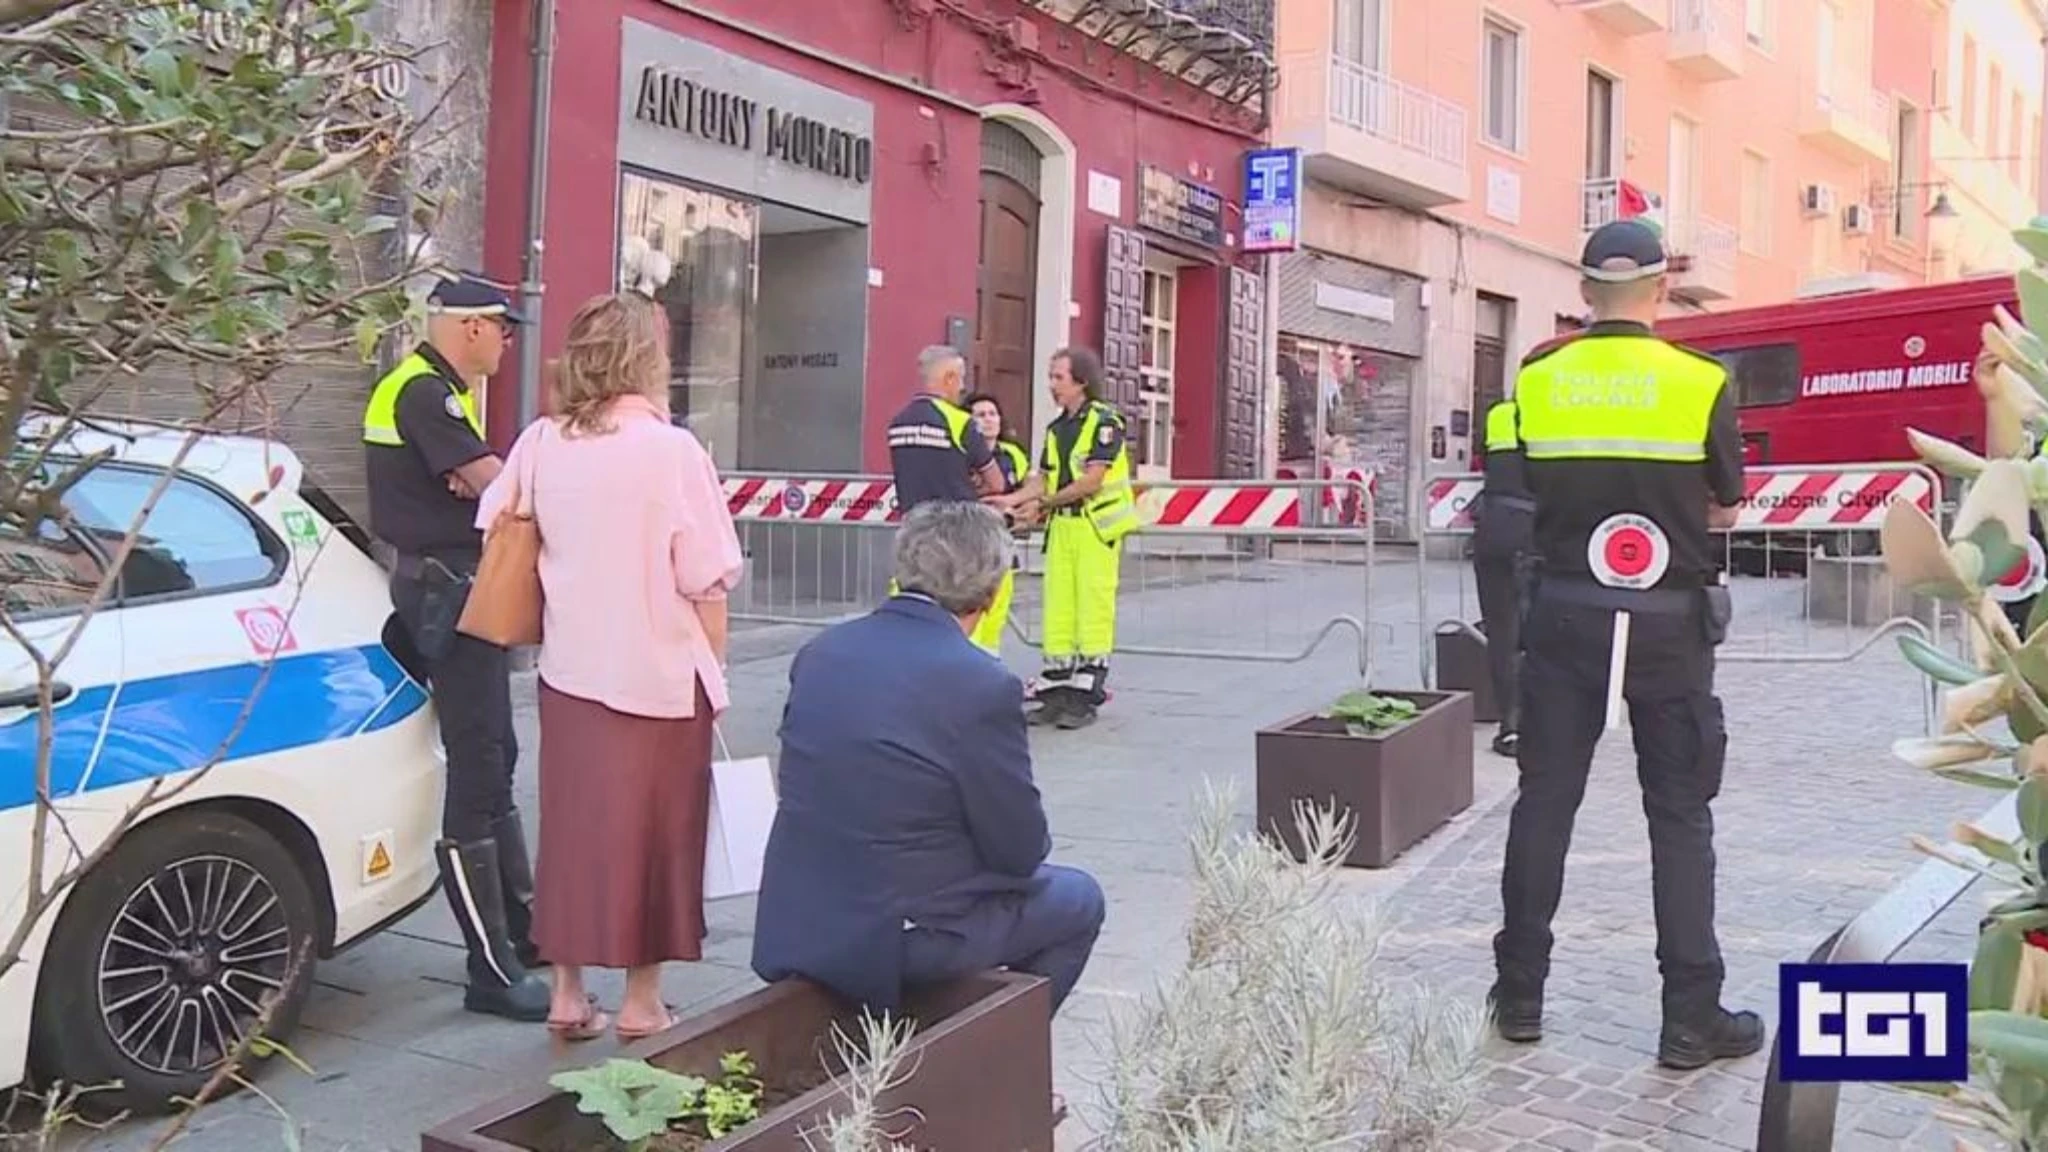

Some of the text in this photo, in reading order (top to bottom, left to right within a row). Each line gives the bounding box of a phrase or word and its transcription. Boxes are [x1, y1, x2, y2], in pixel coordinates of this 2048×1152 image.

[635, 66, 872, 185] ANTONY MORATO
[1802, 361, 1972, 397] LABORATORIO MOBILE
[1551, 389, 1657, 408] LOCALE
[1735, 489, 1829, 509] otezione
